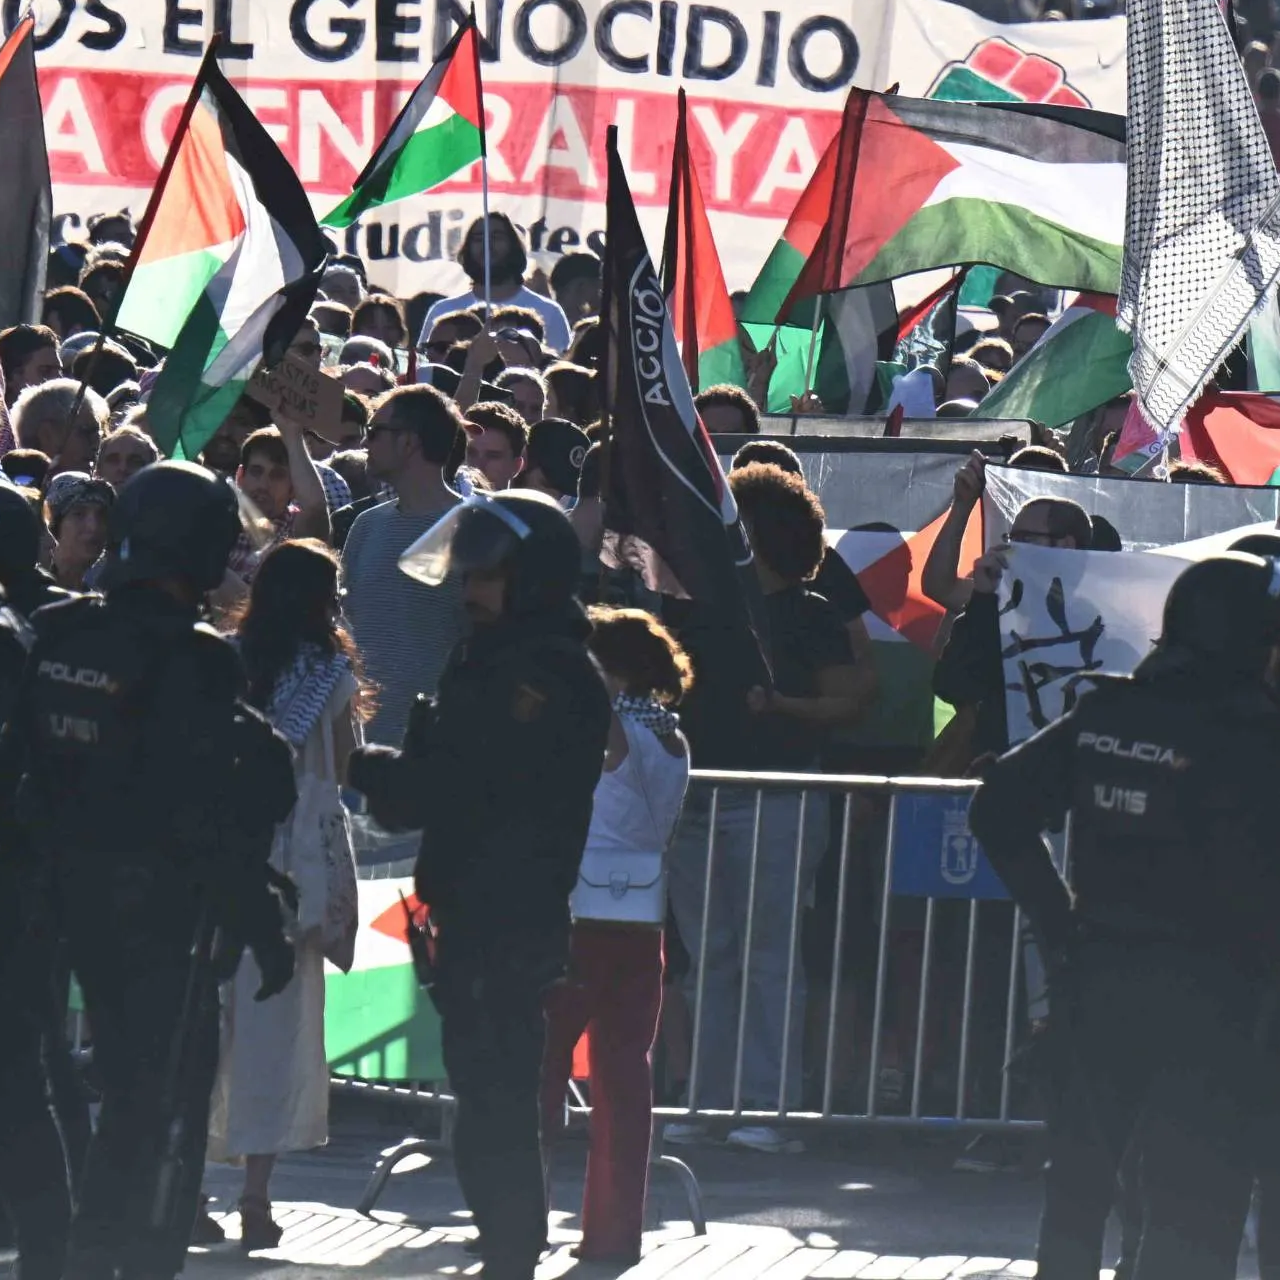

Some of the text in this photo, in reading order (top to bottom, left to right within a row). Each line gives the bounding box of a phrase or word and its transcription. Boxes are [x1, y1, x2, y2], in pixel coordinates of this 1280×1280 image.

[633, 276, 671, 407] ACCIÓ
[36, 659, 109, 689] POLICIA
[1075, 731, 1175, 764] POLICIA
